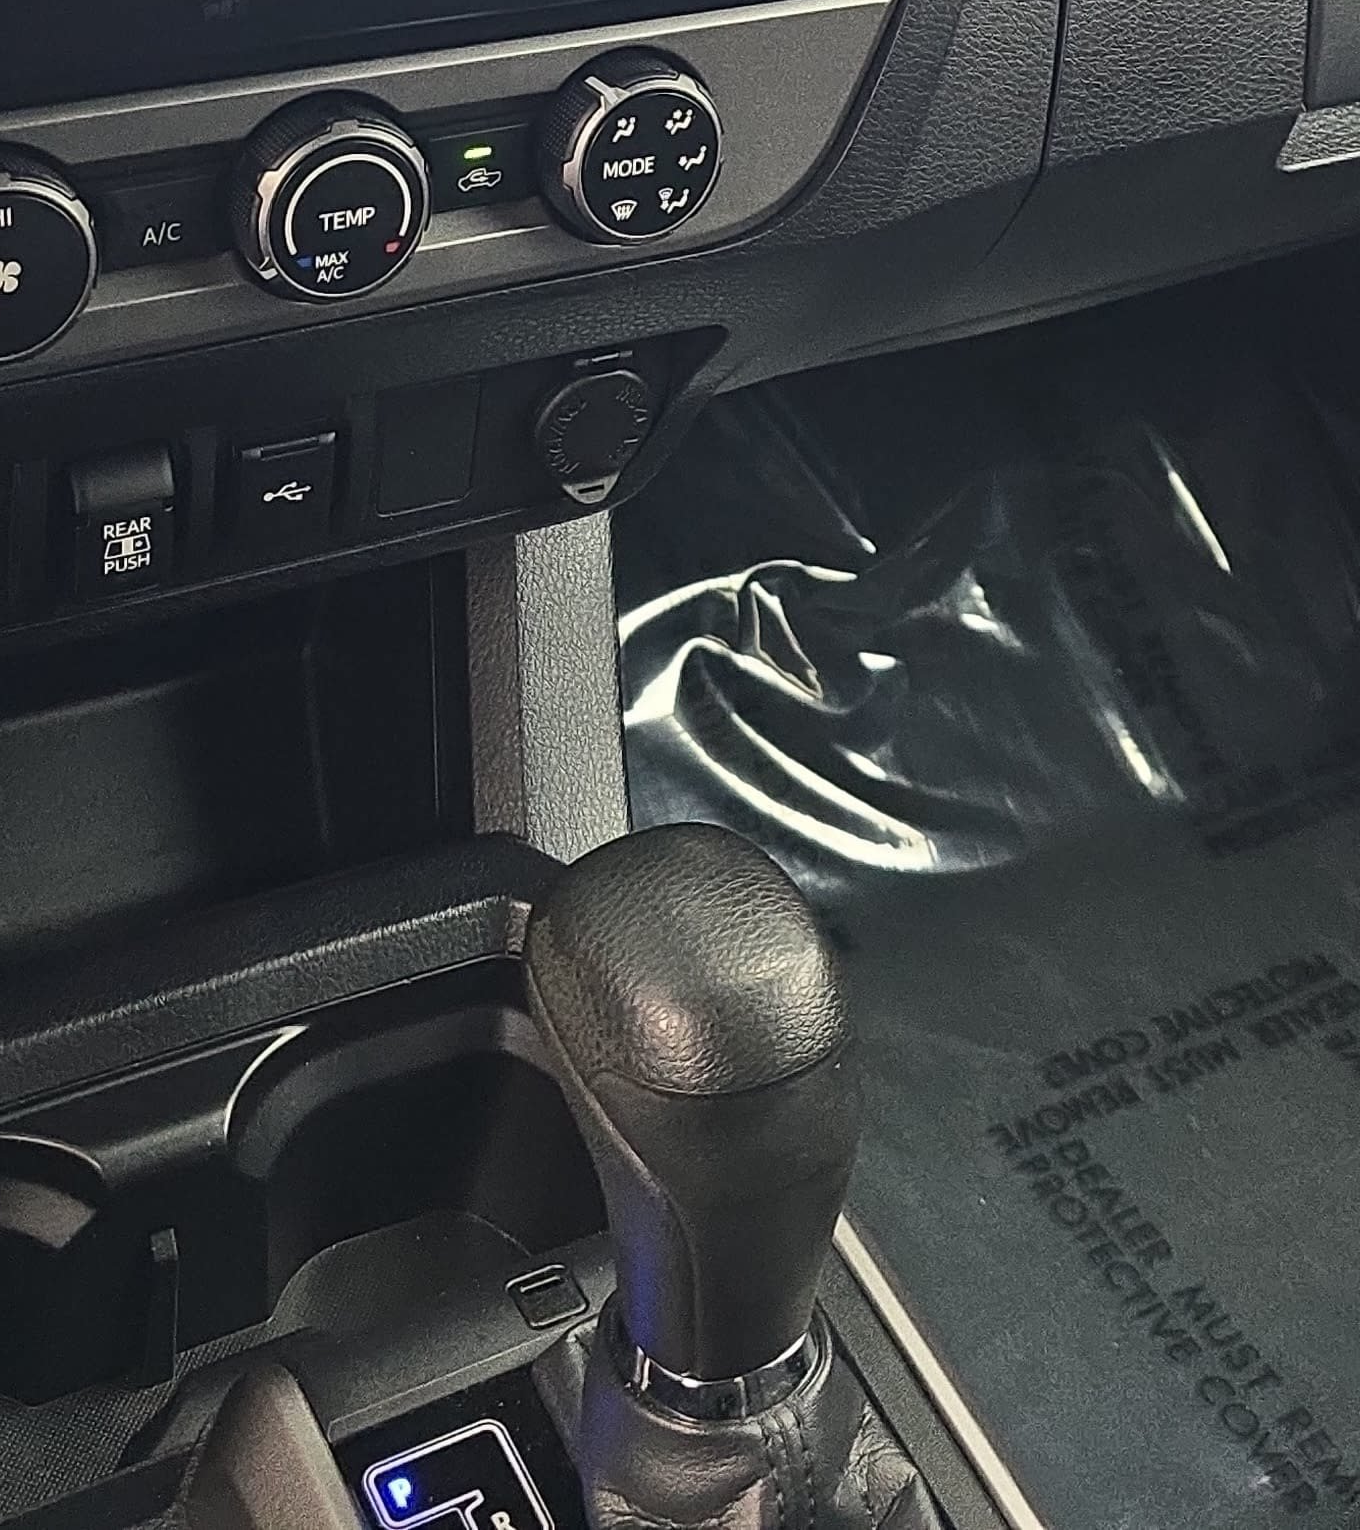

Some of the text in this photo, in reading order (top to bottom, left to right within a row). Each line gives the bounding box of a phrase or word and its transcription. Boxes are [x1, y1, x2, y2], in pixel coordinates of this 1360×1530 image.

[603, 156, 655, 180] MODE
[319, 207, 375, 232] TEMP
[143, 222, 181, 247] A/C
[315, 252, 348, 269] MAX
[317, 267, 344, 283] A/C
[104, 517, 151, 540] REAR
[104, 552, 151, 574] PUSH
[1057, 1137, 1173, 1269] DEALER
[1168, 1280, 1282, 1391] MUST
[1018, 1153, 1318, 1513] PROTECTIVE COVER
[388, 1478, 411, 1507] P
